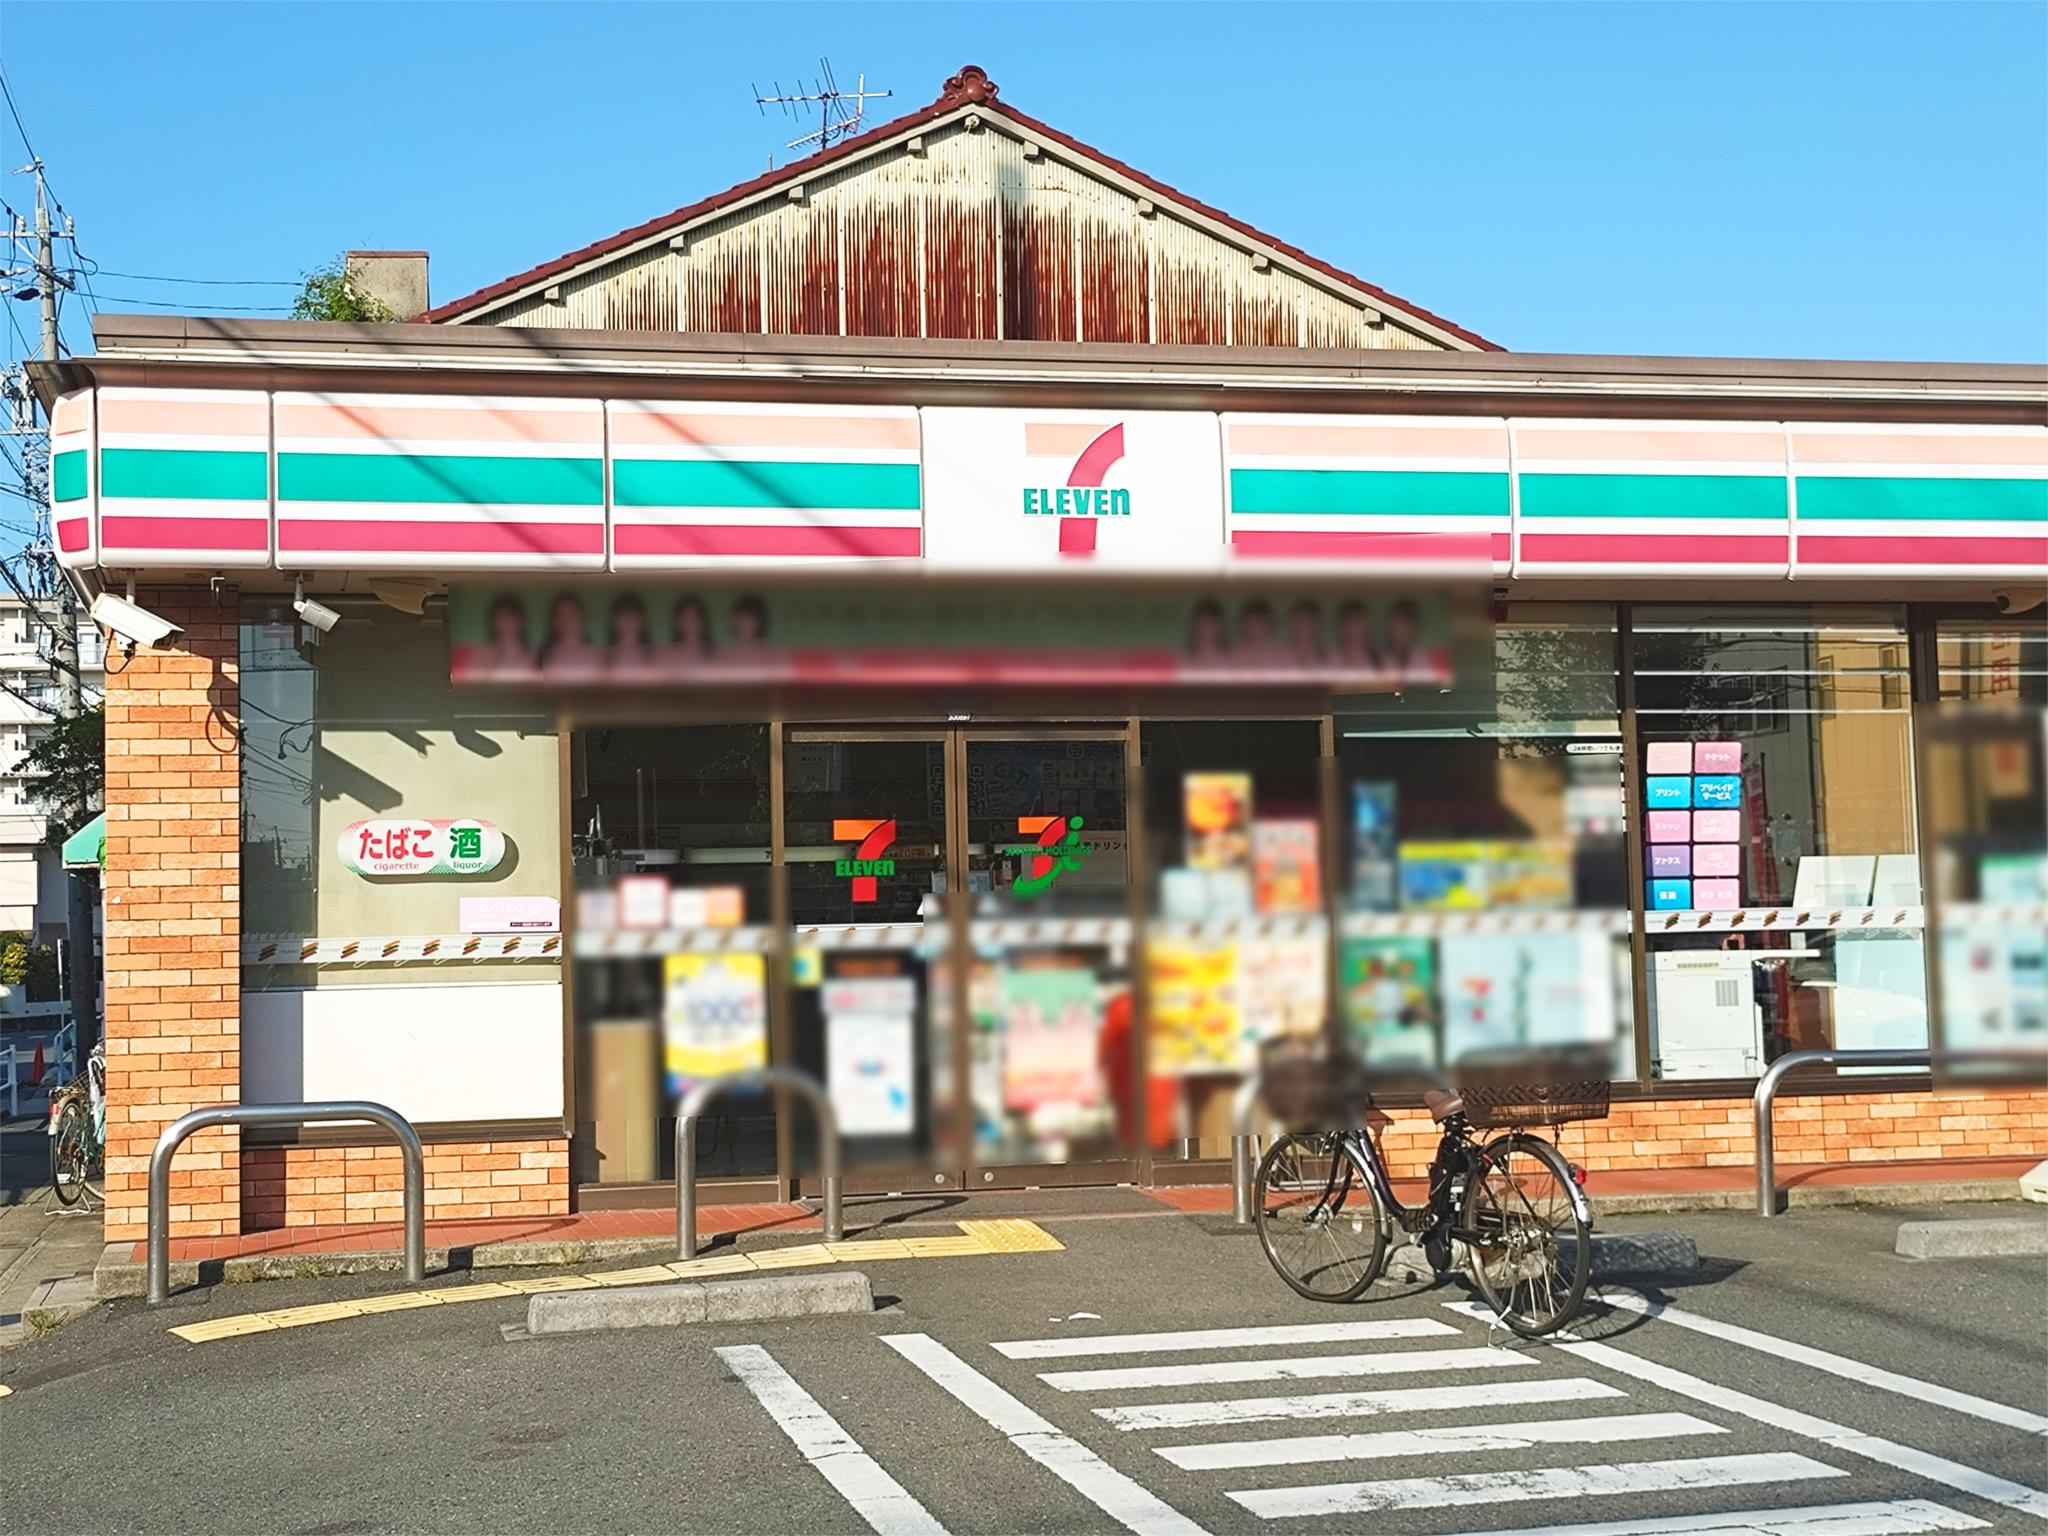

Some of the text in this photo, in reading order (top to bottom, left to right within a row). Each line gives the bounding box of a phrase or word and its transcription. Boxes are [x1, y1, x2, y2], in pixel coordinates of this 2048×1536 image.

[1655, 788, 1681, 797] プリント
[1702, 792, 1731, 800] サービス
[359, 827, 482, 860] たばこ 酒
[1655, 856, 1681, 865] ファクス
[373, 860, 483, 872] cigarette liquor
